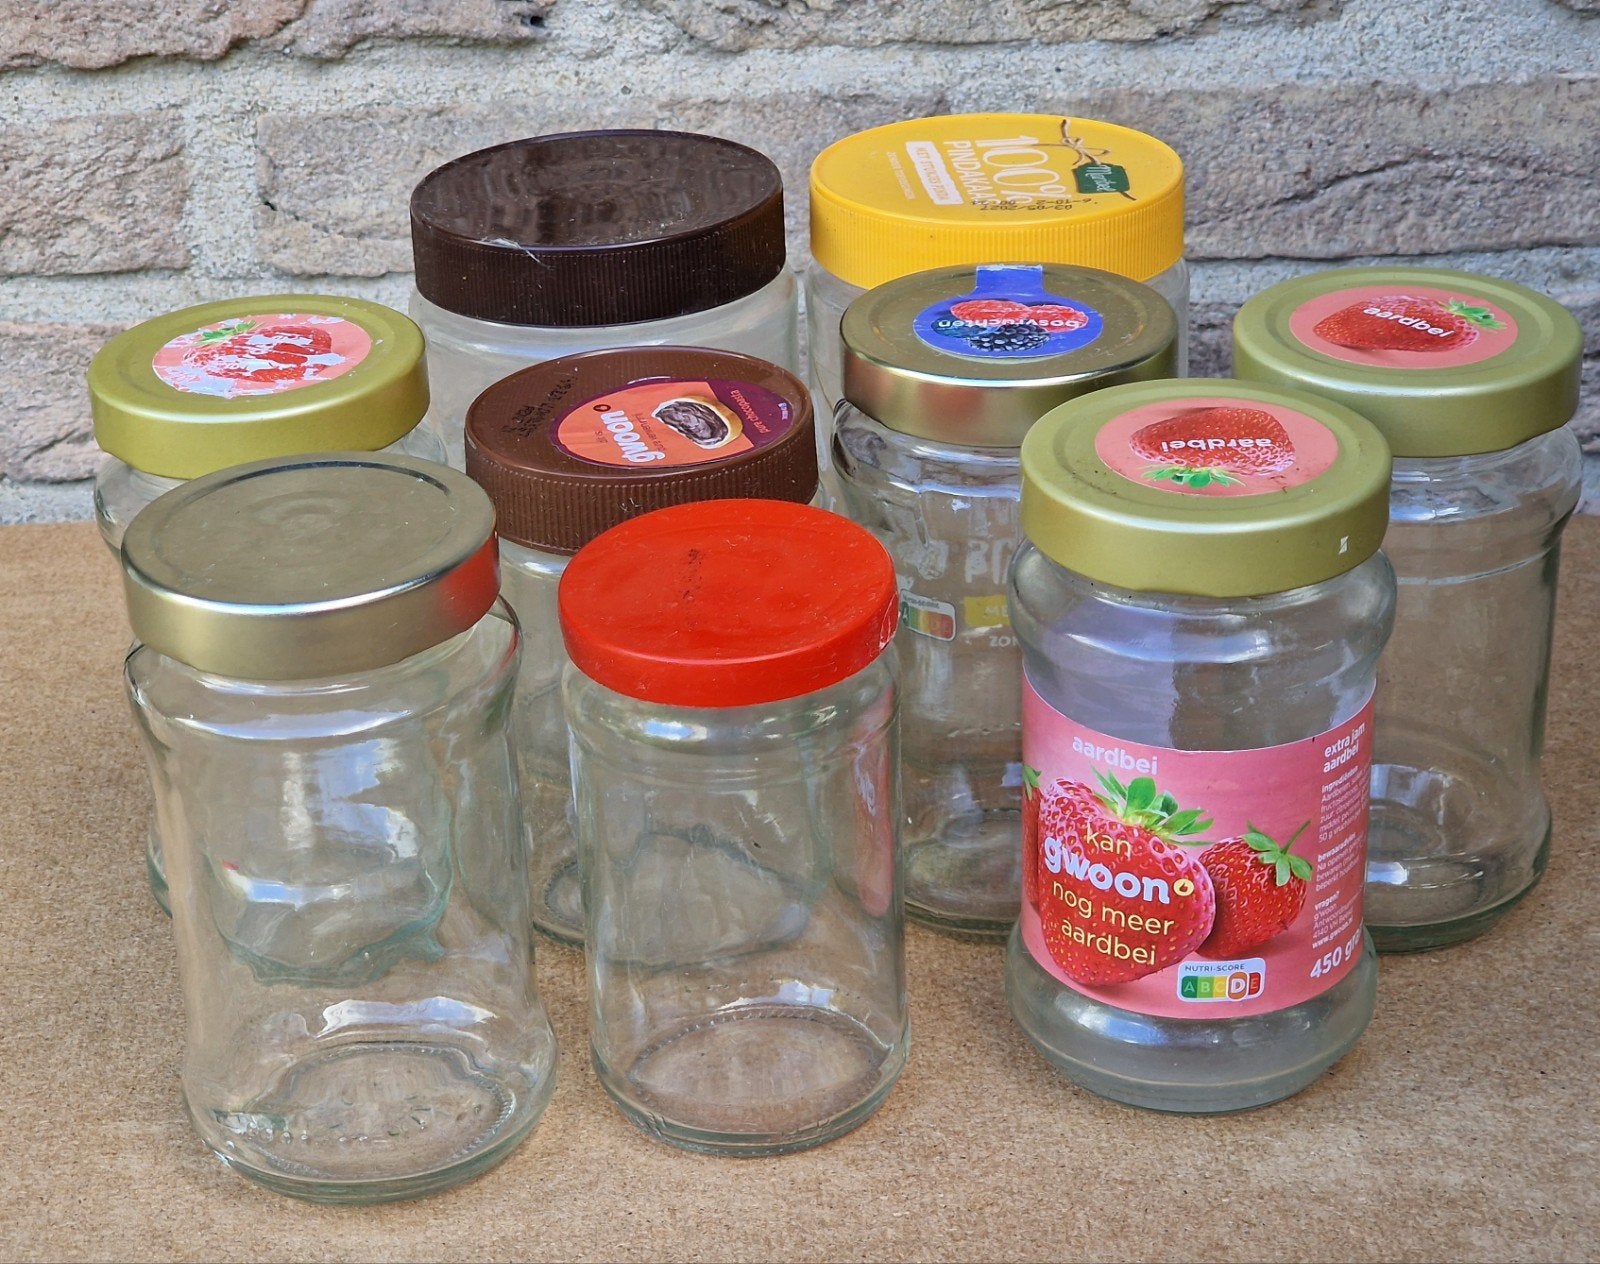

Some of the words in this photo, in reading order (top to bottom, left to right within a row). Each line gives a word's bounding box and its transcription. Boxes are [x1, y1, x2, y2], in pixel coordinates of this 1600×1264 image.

[942, 139, 1002, 206] PINDAKAAS
[975, 135, 1072, 204] 100%
[938, 318, 1080, 328] bosvruchten
[1363, 307, 1454, 337] aardbei
[729, 388, 757, 422] chocopasta
[1161, 438, 1272, 453] aardbei
[1073, 736, 1158, 775] aardbei
[1323, 740, 1359, 773] aardbei
[1324, 735, 1351, 758] extra
[1351, 722, 1365, 745] jam
[1086, 822, 1132, 859] kan
[1053, 881, 1093, 918] nog
[1102, 902, 1175, 936] meer
[1061, 917, 1157, 966] aardbei
[1185, 963, 1245, 972] NUTRI-SCORE
[1310, 946, 1342, 979] 450
